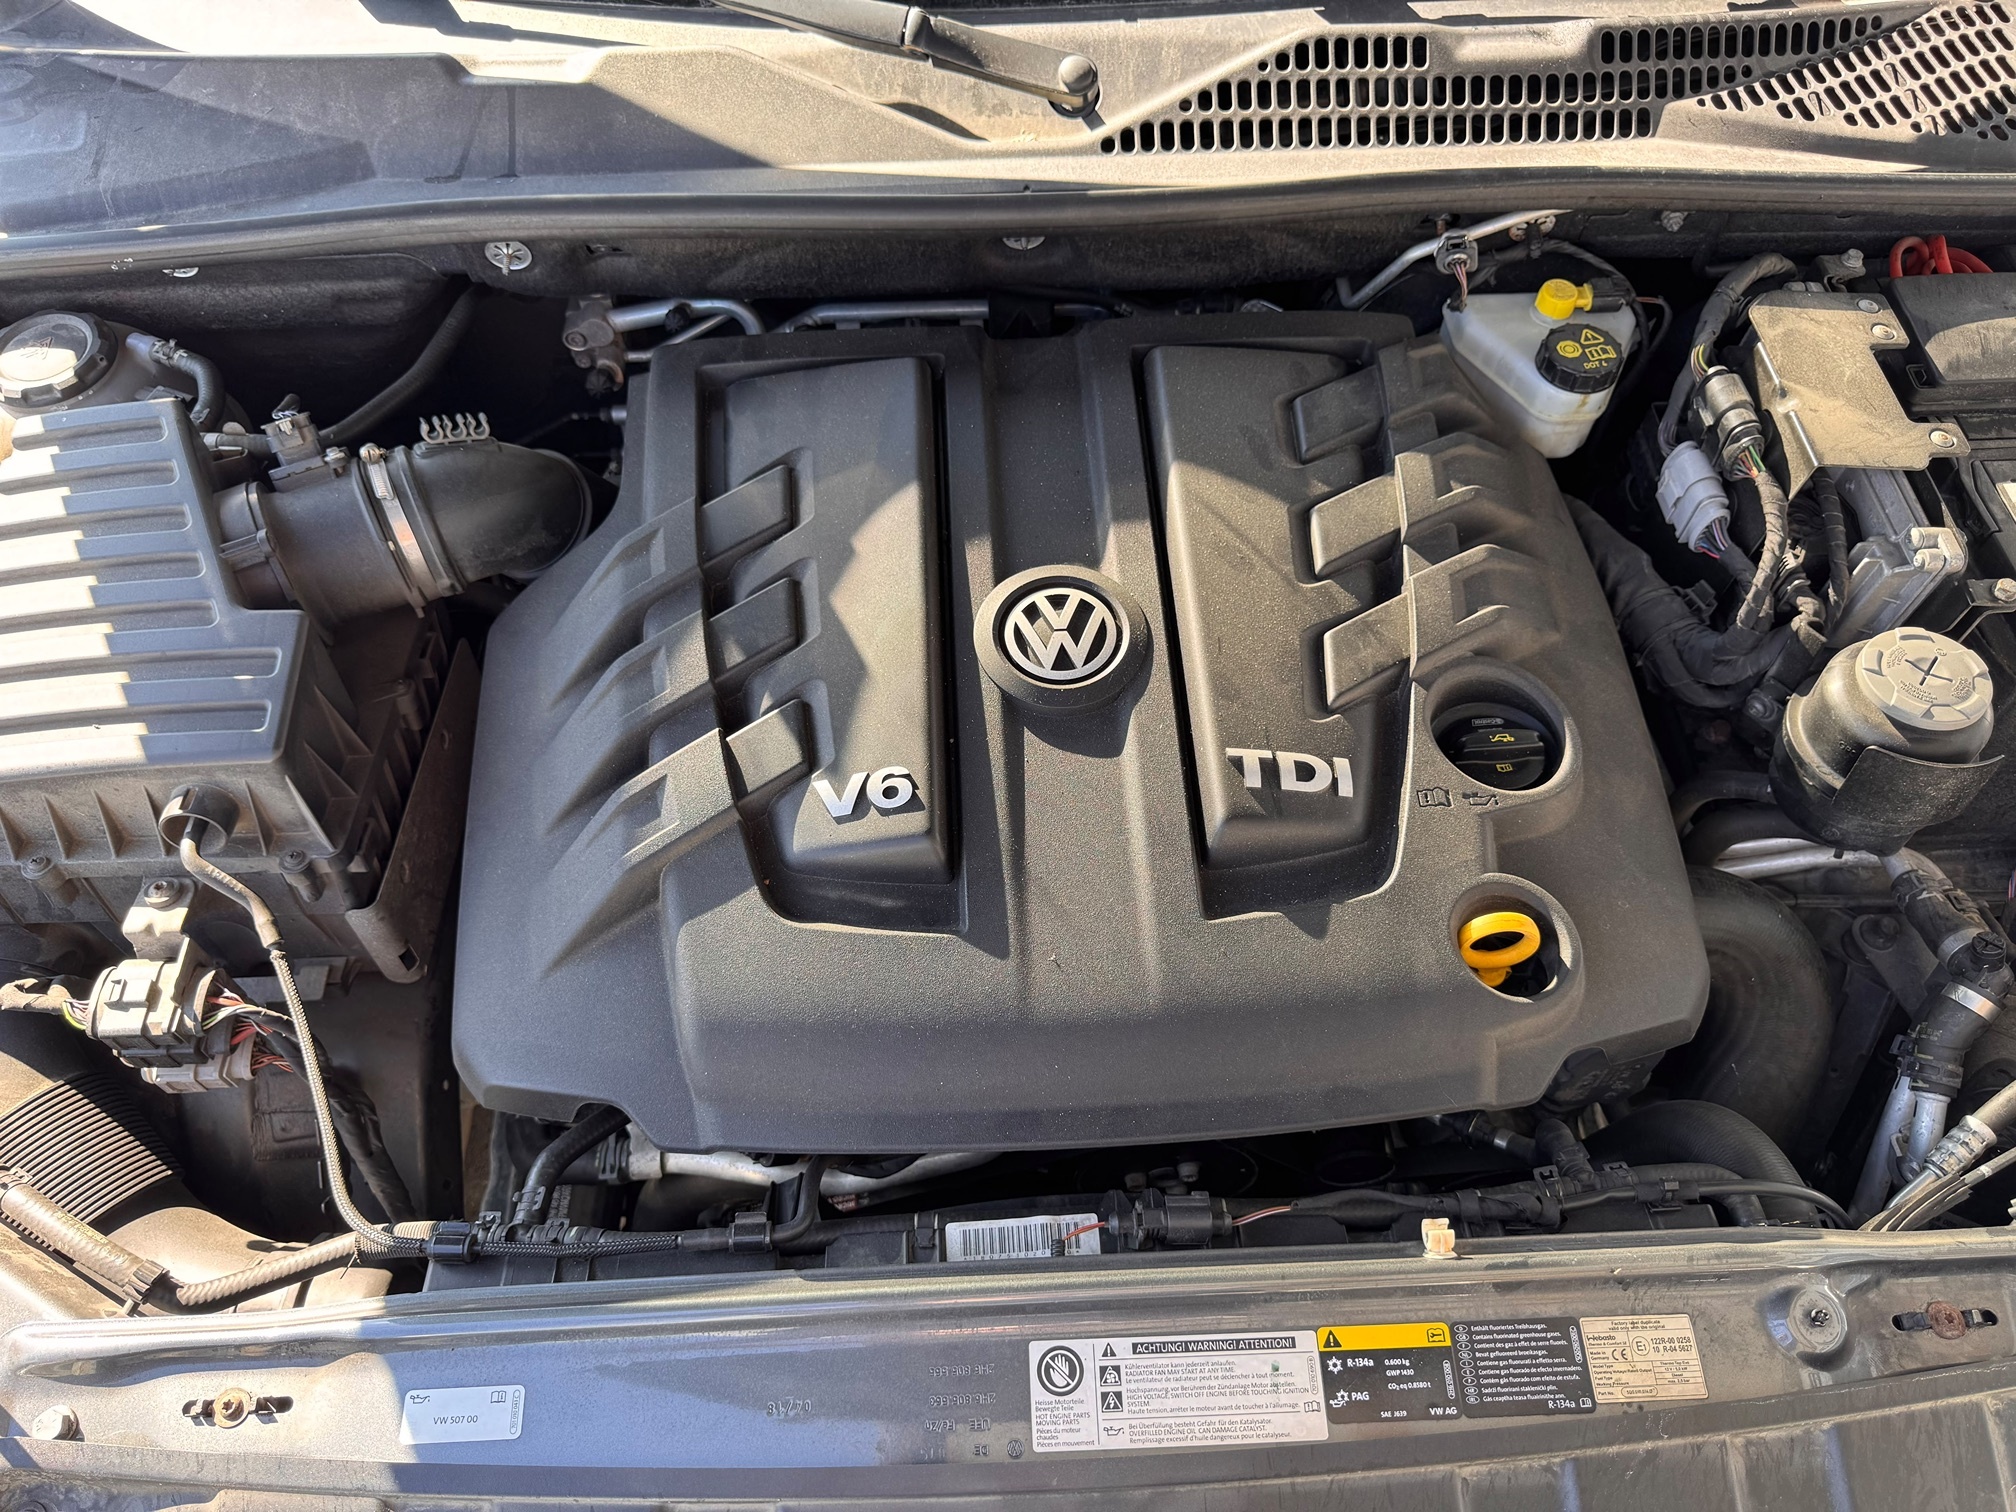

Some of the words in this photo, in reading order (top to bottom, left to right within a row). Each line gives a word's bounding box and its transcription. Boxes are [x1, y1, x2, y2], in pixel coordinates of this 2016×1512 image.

[1583, 361, 1600, 369] DOT
[1004, 587, 1117, 680] VW
[1226, 748, 1353, 798] TDI
[812, 766, 914, 818] V6
[1136, 1342, 1185, 1353] ACHTUNG!
[1187, 1340, 1236, 1351] WARNING!
[1238, 1338, 1292, 1349] ATTENTION!
[1185, 1361, 1210, 1369] jederzeit
[1346, 1358, 1374, 1367] R-134a
[1401, 1358, 1410, 1367] kg
[1199, 1375, 1212, 1383] peut
[1220, 1372, 1250, 1380] déclencher
[1217, 1383, 1250, 1391] Zündanlage
[1143, 1392, 1170, 1400] VOLTAGE,
[1351, 1392, 1370, 1401] PAG
[1548, 1399, 1576, 1409] R-134a
[1035, 1405, 1060, 1413] Bewegte
[1429, 1407, 1443, 1415] VW
[1445, 1407, 1457, 1415] AG
[433, 1417, 449, 1425] VW
[450, 1416, 465, 1424] 507
[466, 1415, 478, 1423] 00
[1138, 1421, 1173, 1430] Überfüllung
[1129, 1429, 1163, 1437] OVERFILLED
[1164, 1428, 1185, 1436] ENGINE
